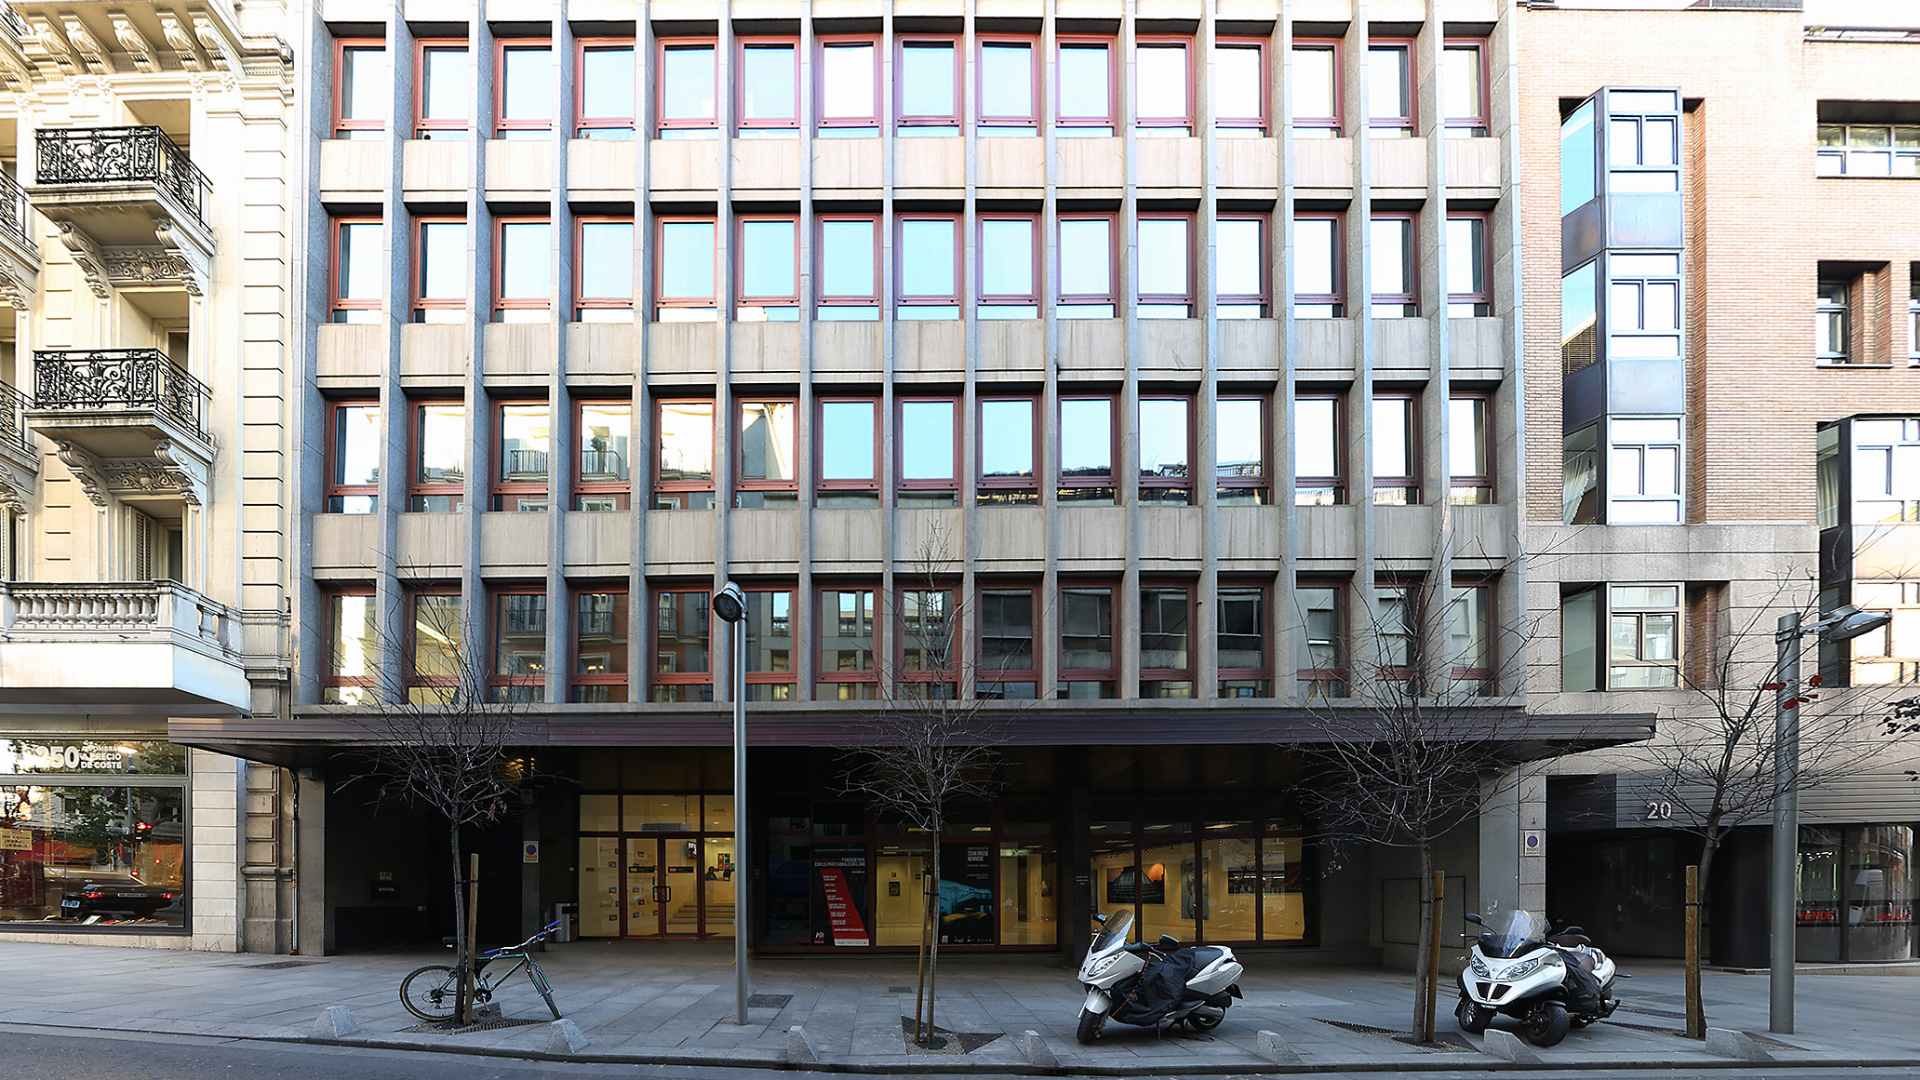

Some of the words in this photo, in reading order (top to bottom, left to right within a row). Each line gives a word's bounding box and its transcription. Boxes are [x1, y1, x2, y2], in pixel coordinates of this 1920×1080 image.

[81, 761, 93, 769] DE
[94, 761, 122, 769] COSTE
[1647, 802, 1672, 819] 20
